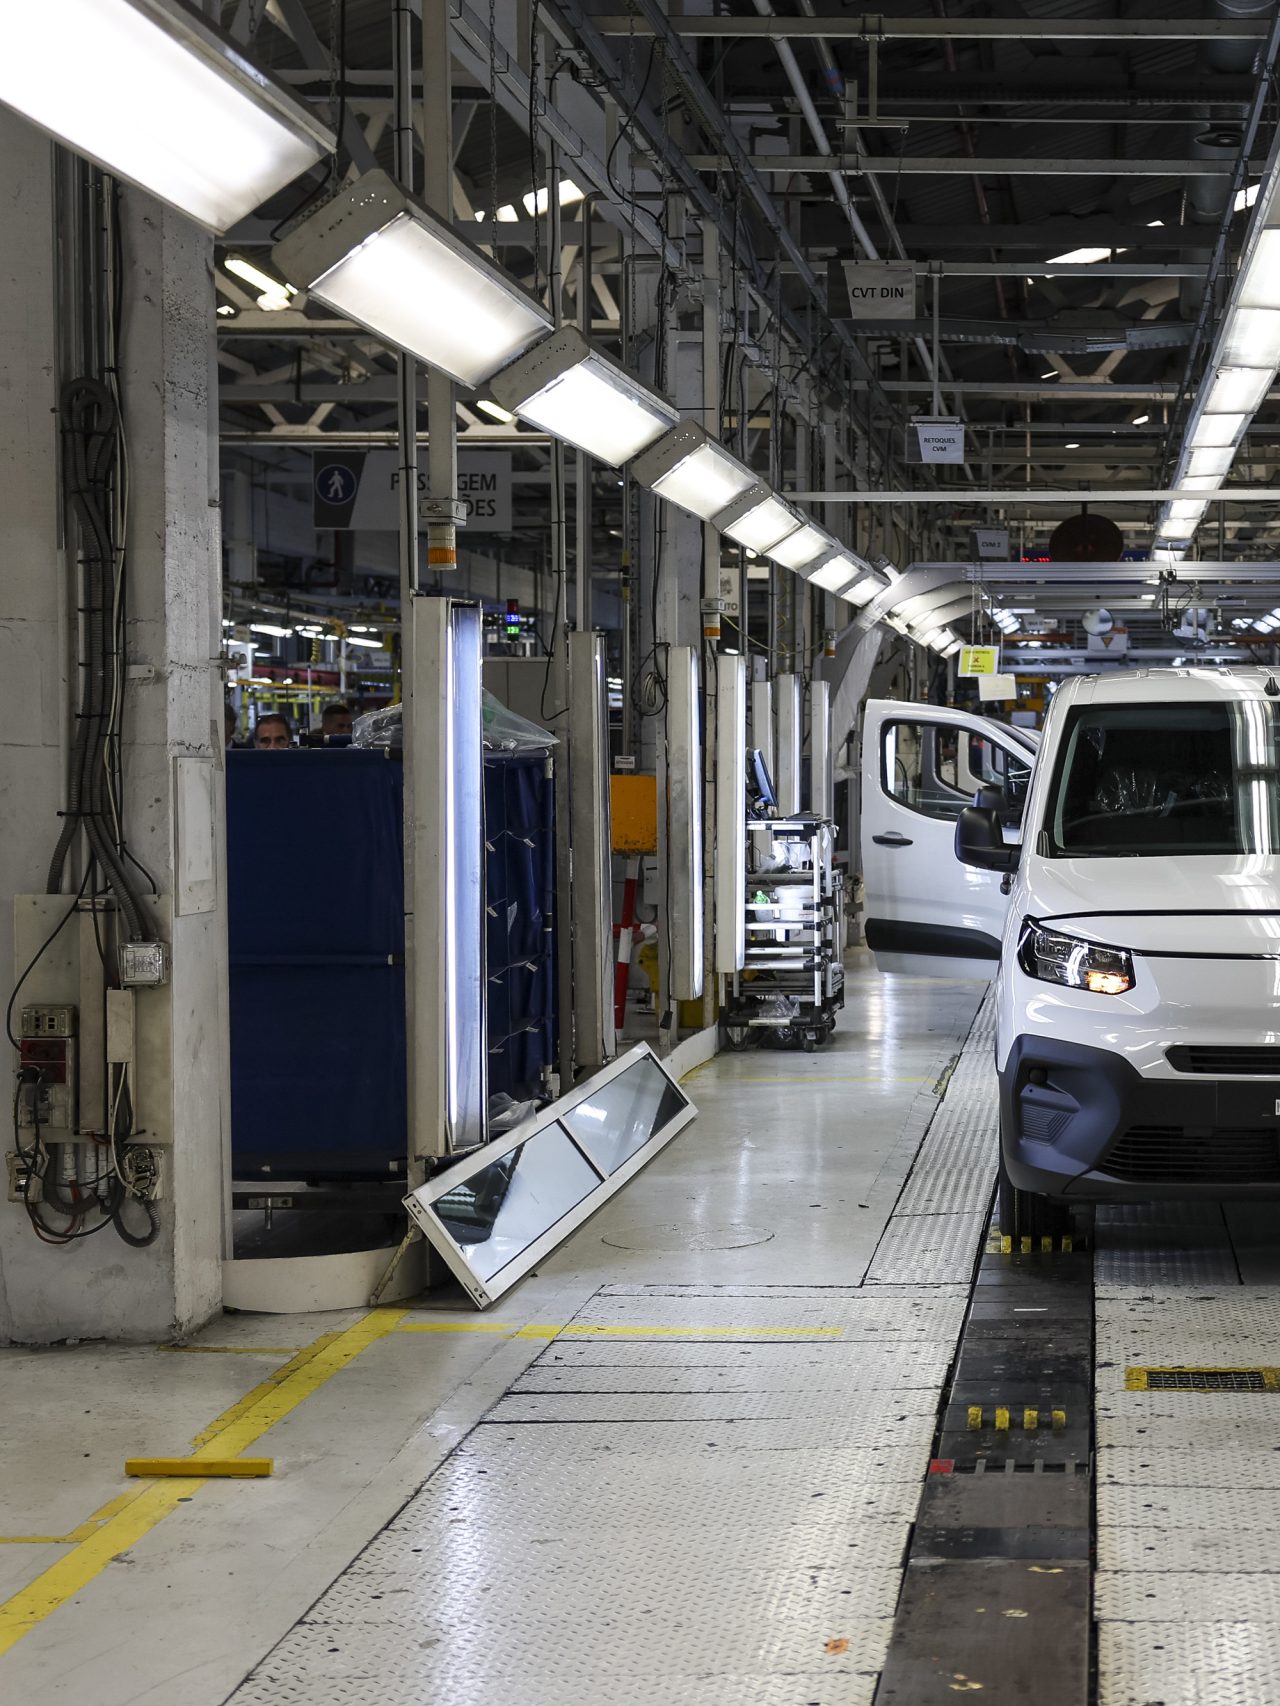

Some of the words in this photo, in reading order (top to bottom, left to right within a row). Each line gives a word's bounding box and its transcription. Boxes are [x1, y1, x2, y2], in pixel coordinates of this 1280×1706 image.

[852, 287, 877, 298] CVT
[880, 287, 904, 298] DIN
[390, 473, 497, 491] PSGEM
